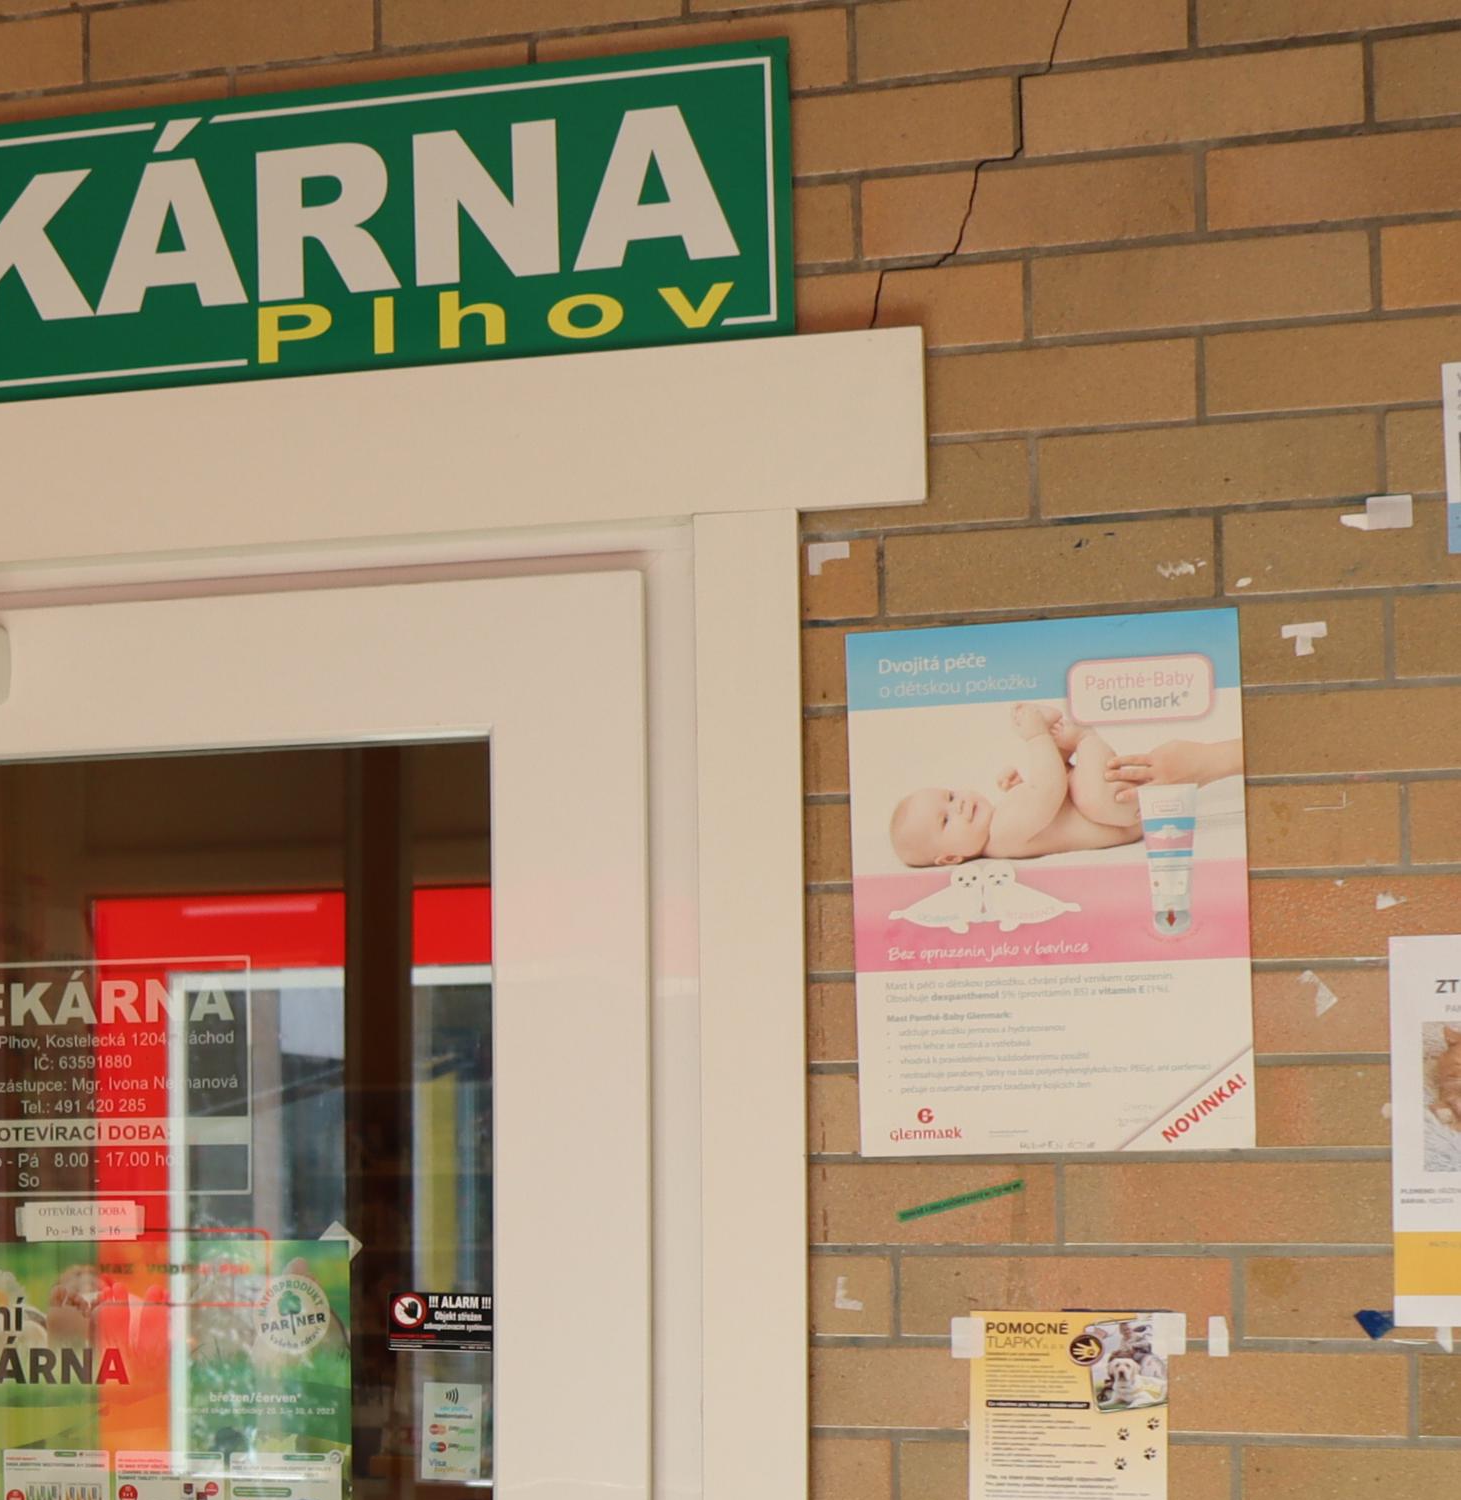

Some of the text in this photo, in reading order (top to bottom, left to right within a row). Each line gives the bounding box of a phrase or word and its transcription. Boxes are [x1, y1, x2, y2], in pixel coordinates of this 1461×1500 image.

[257, 281, 733, 363] Plhov
[878, 653, 987, 676] Dvojitá péče
[879, 674, 1037, 699] o dětskou pokožku
[1085, 670, 1194, 691] Panthé-Baby
[888, 940, 1090, 963] Bez opruzenin jako v bavlnce
[46, 1033, 126, 1049] Kostelecká
[178, 1029, 235, 1045] áchod
[34, 1055, 132, 1070] IČ: 63591880
[72, 1078, 103, 1095] Mgr.
[109, 1077, 149, 1091] Ivona
[21, 1098, 146, 1115] Tel.: 491 420 285
[1162, 1073, 1247, 1145] NOVINKA!
[18, 1151, 39, 1169] Pá
[54, 1153, 88, 1167] 8.00
[106, 1152, 150, 1167] 17.00
[18, 1173, 40, 1188] So
[38, 1206, 127, 1217] OTEVÍRACÍ DOBA
[45, 1225, 121, 1236] Po Pá 8 16
[441, 1295, 479, 1309] ALARM
[986, 1320, 1069, 1335] POMOCNÉ
[987, 1336, 1044, 1350] TLAPKY
